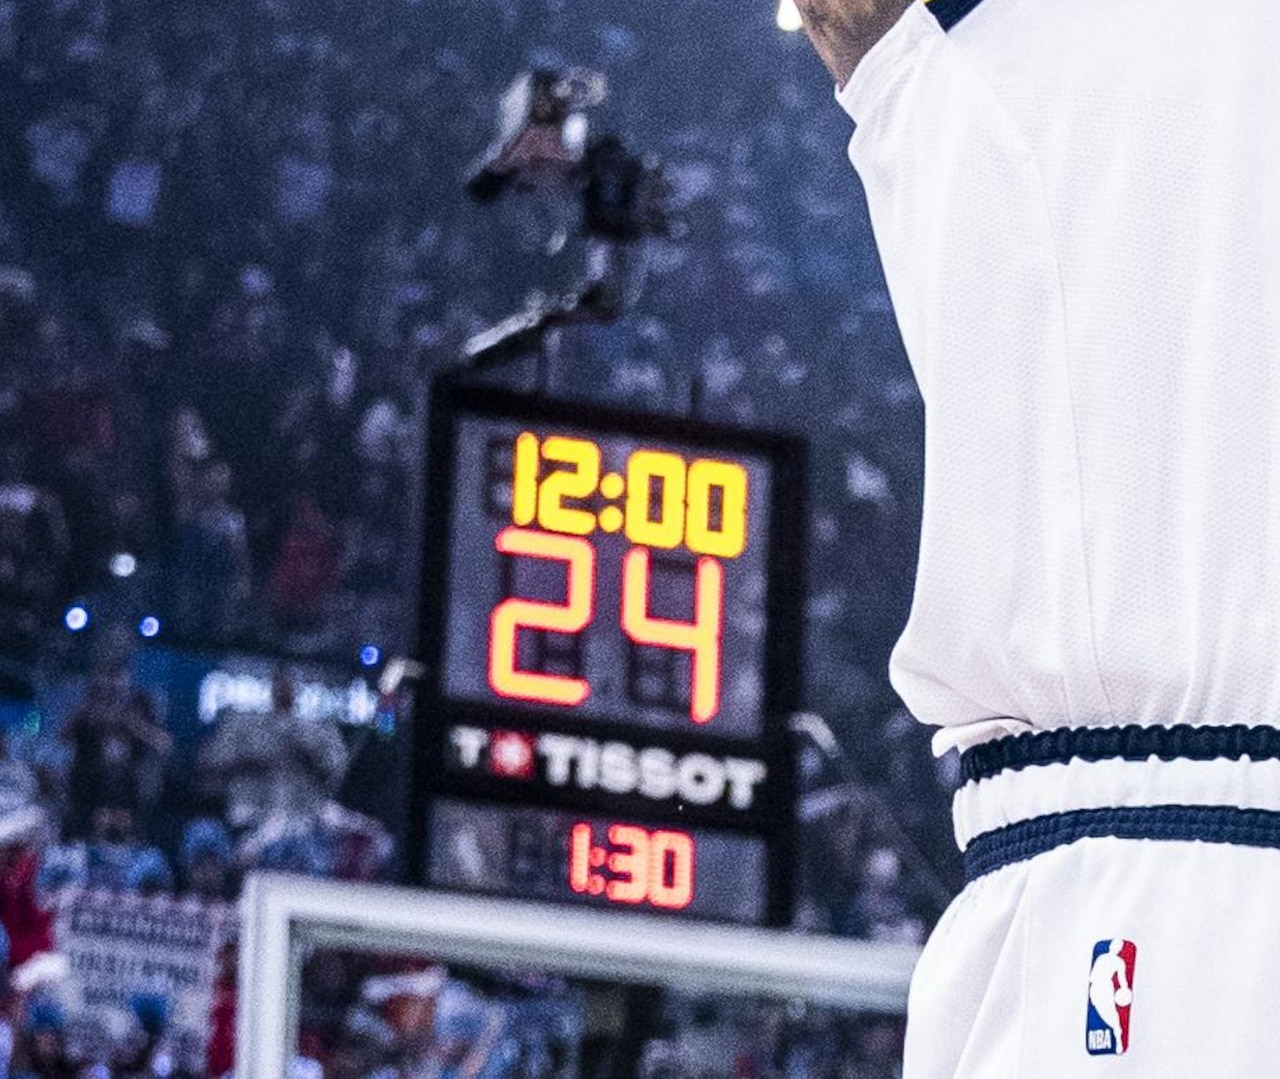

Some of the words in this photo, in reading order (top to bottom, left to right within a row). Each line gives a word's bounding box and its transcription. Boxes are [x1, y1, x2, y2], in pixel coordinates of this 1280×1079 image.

[512, 431, 748, 560] 12:00
[488, 524, 724, 724] 24
[536, 732, 767, 810] TISSOT
[568, 822, 696, 910] 1:30
[1087, 1028, 1112, 1050] NBA
